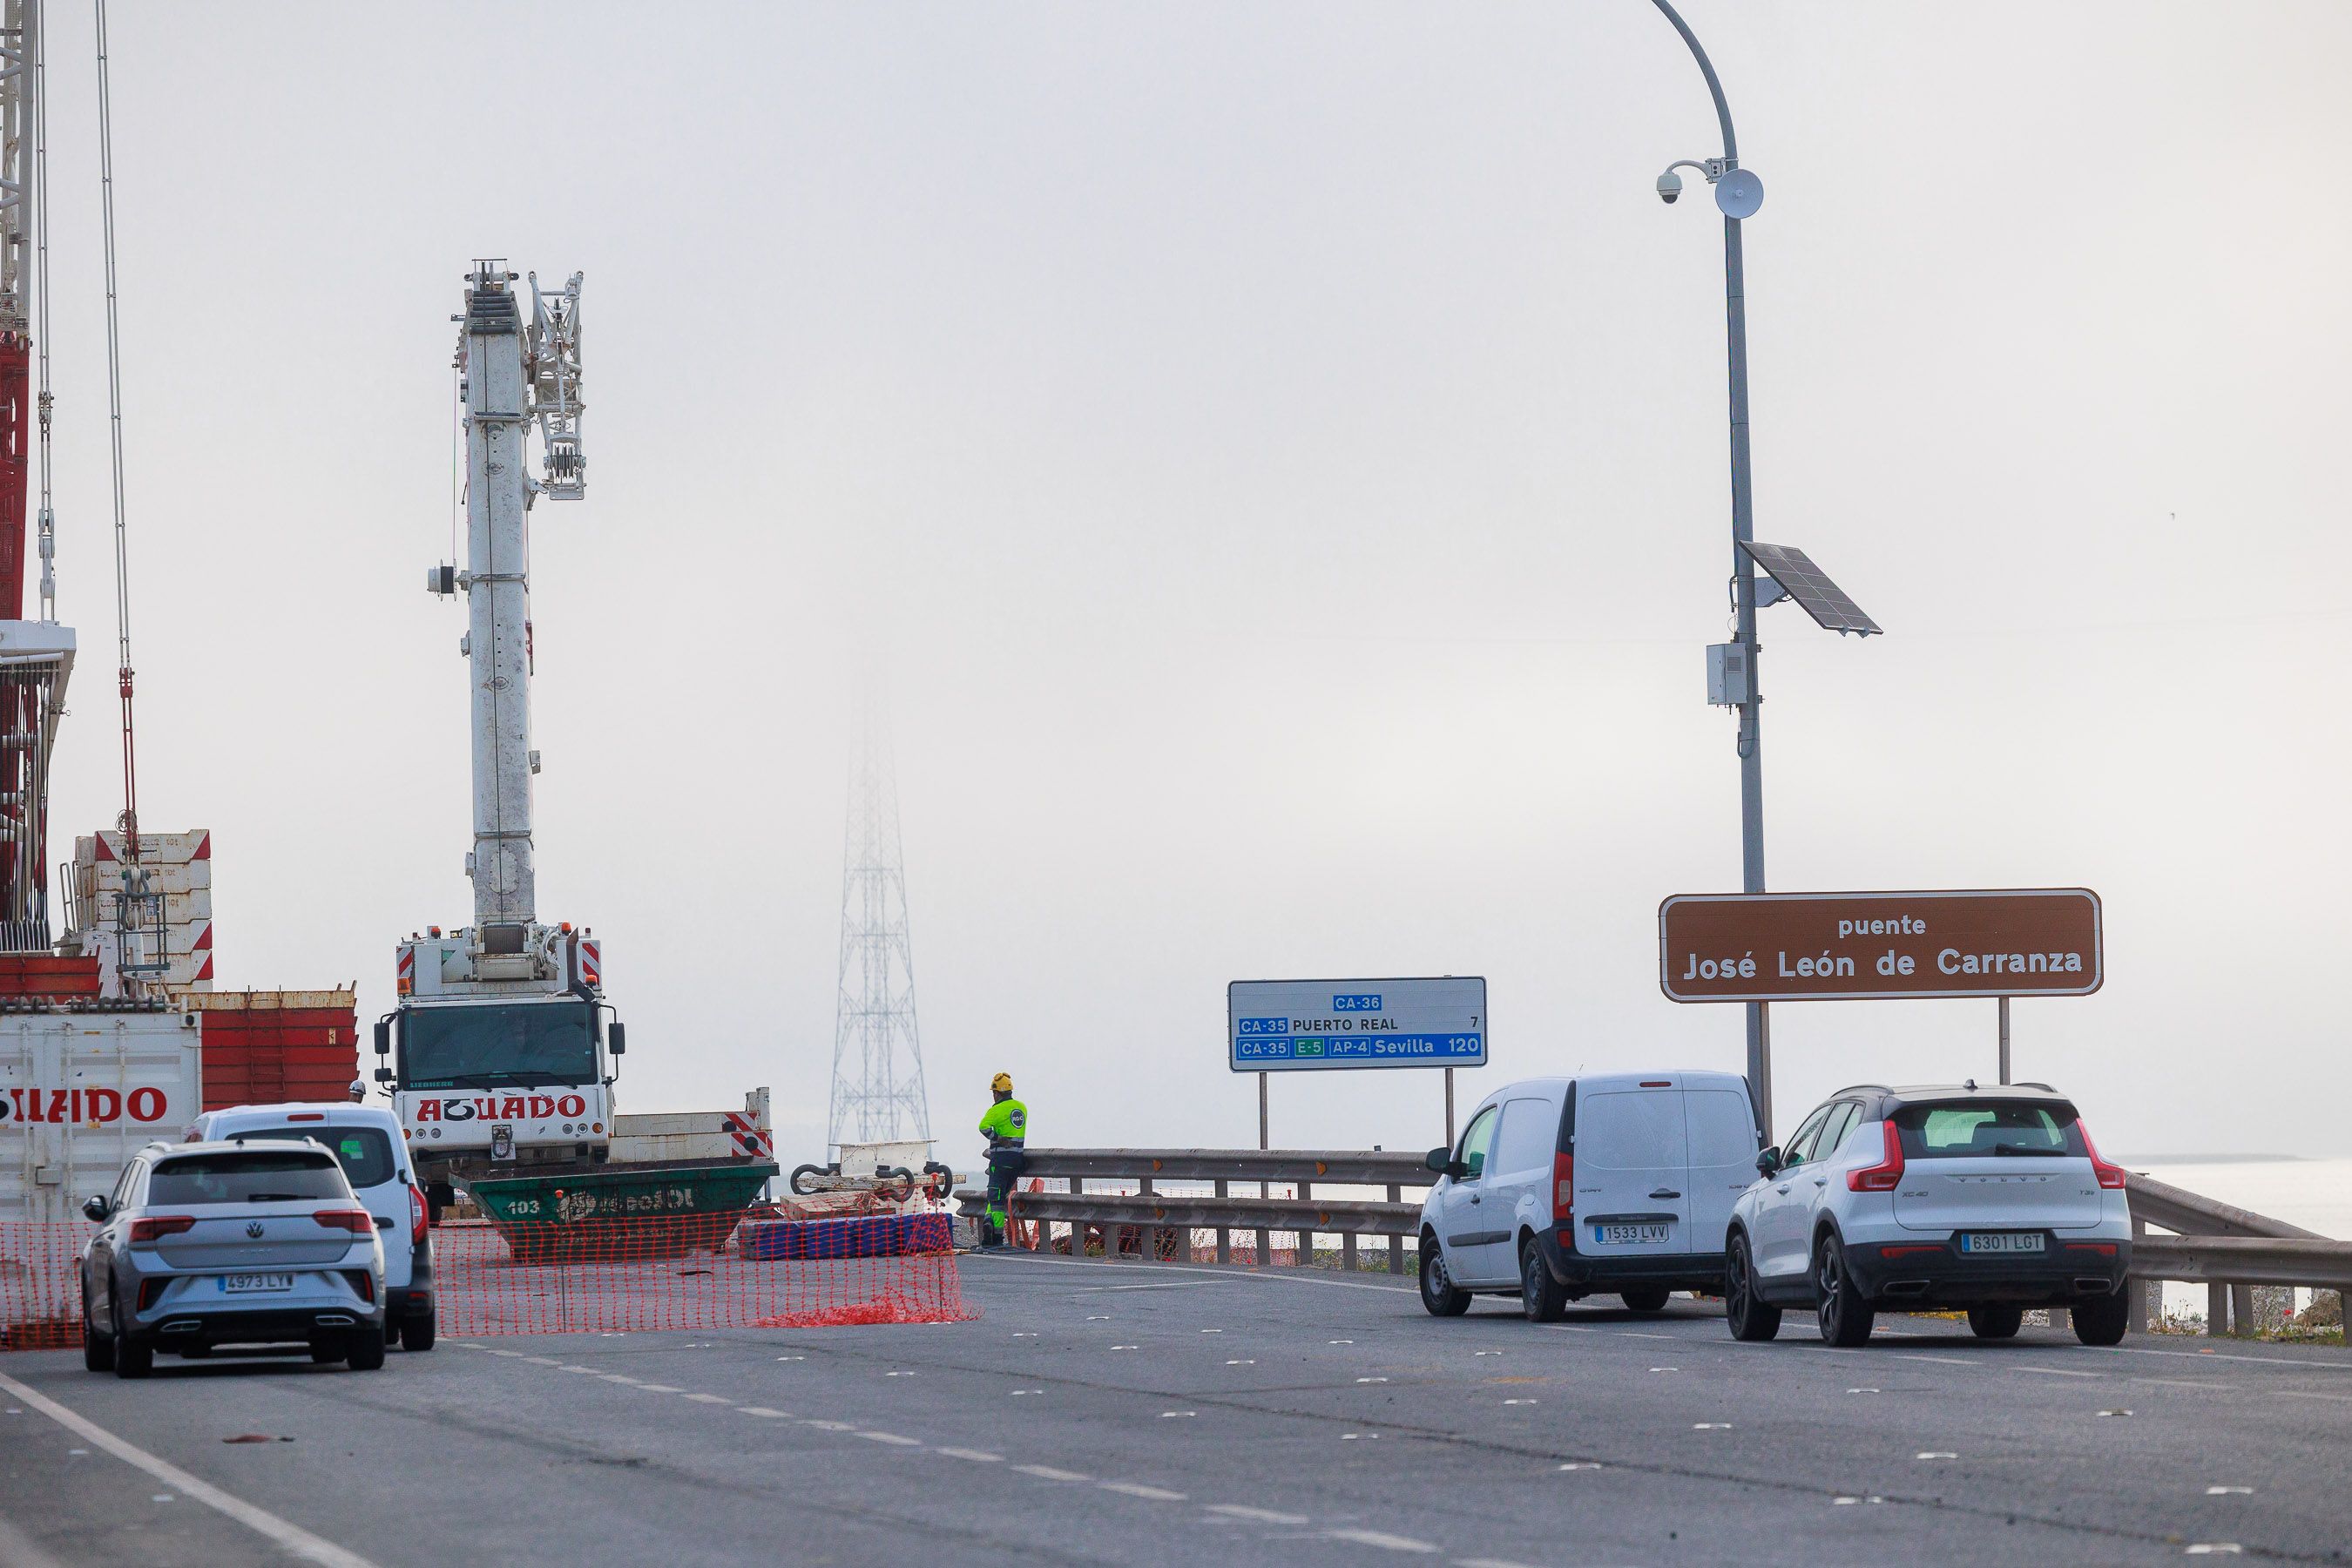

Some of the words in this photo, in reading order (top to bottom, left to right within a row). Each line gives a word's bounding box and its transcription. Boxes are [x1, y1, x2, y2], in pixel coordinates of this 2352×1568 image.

[1839, 915, 1926, 938] puente
[1684, 951, 1757, 980] José
[1779, 950, 1855, 977] León
[1876, 950, 1916, 976] de
[1938, 949, 2082, 975] Carranza
[1335, 997, 1380, 1010] CA-36
[1240, 1020, 1287, 1033] CA-35
[1293, 1018, 1353, 1031] PUERTO
[1361, 1017, 1398, 1031] REAL
[1470, 1017, 1478, 1028] 7
[1241, 1042, 1287, 1055] CA-35
[1297, 1041, 1321, 1053] E-5
[1333, 1040, 1369, 1053] AP-4
[1375, 1037, 1434, 1054] Sevilla
[1449, 1037, 1479, 1052] 120
[0, 1086, 167, 1123] UADO
[508, 1200, 540, 1215] 103
[1606, 1227, 1638, 1240] 1533
[1641, 1226, 1666, 1239] LVV
[1973, 1236, 2009, 1250] 6301
[2013, 1235, 2041, 1249] LGT
[227, 1274, 263, 1289] 4973
